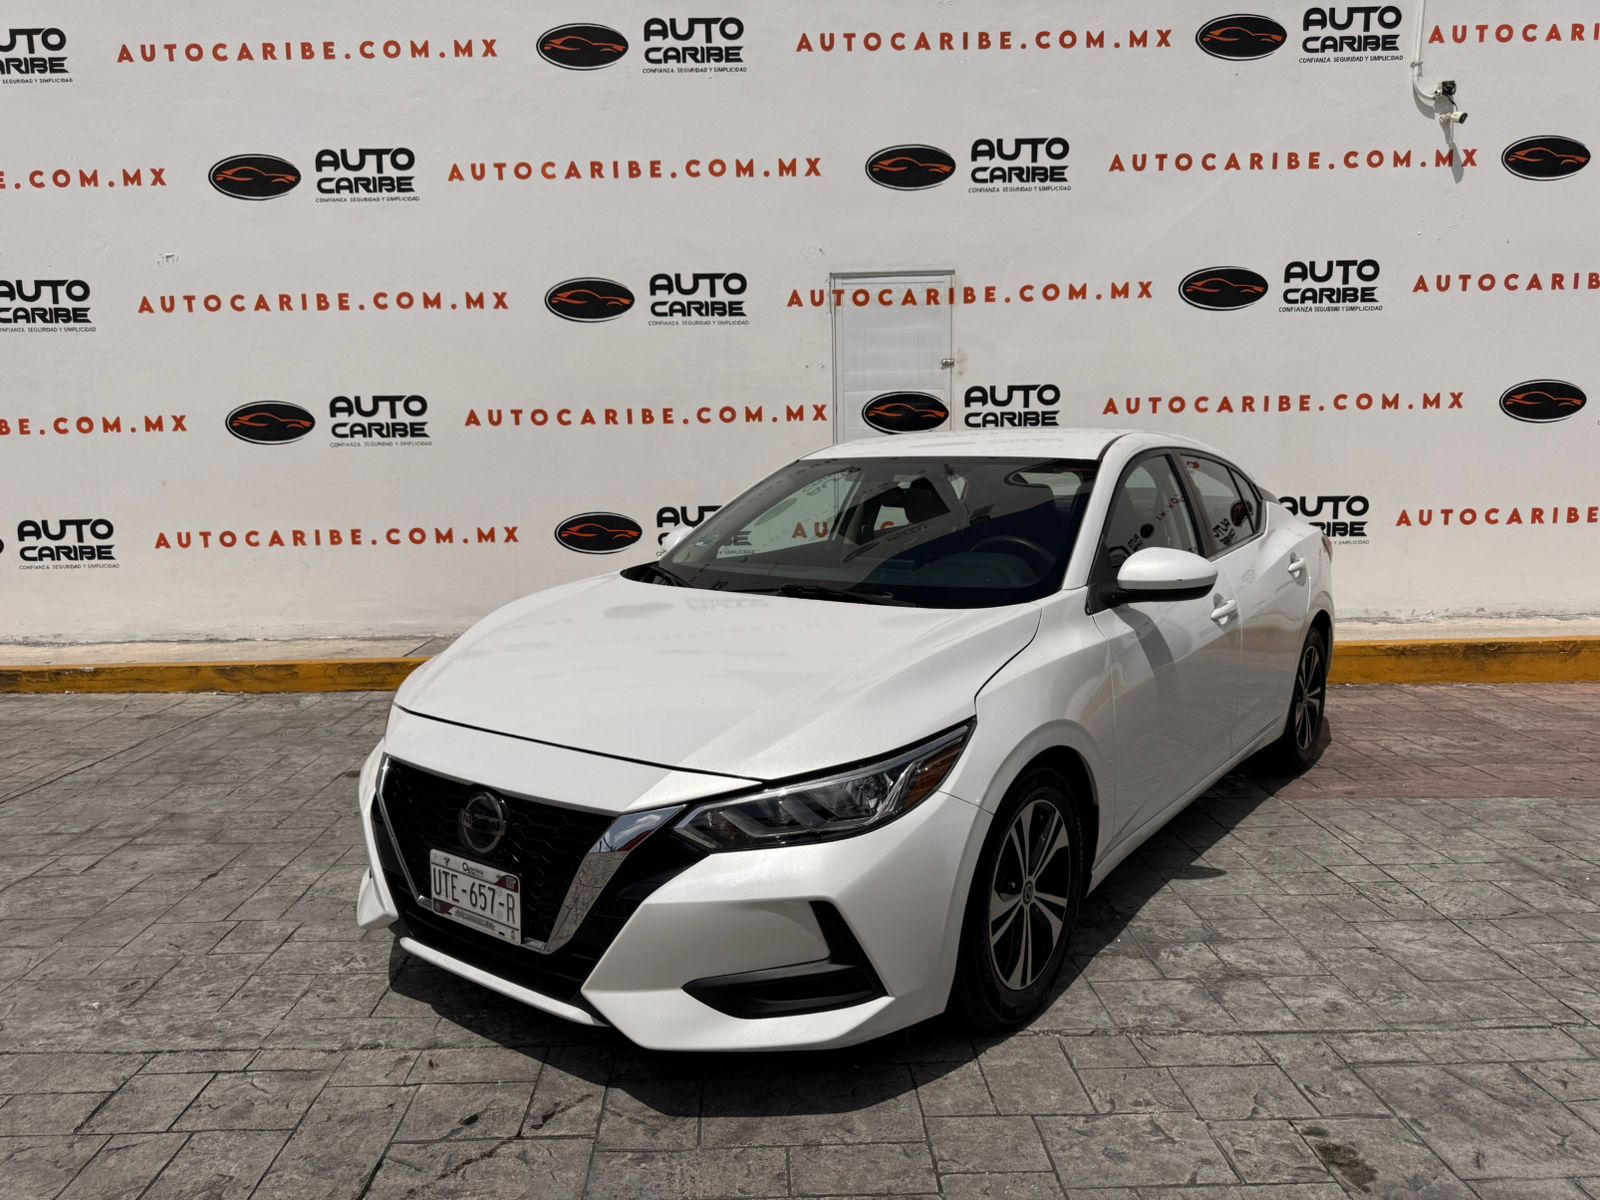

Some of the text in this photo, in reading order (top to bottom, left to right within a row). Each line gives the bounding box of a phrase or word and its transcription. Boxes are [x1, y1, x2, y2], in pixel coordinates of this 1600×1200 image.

[644, 17, 745, 43] AUTO
[1303, 5, 1402, 32] AUTO
[118, 39, 498, 63] AUTOCARIBE.COM.MX
[796, 31, 1172, 53] AUTOCARIBE.COM.MX
[1302, 35, 1401, 54] CARIBE
[644, 46, 744, 64] CARIBE
[315, 147, 415, 174] AUTO
[971, 138, 1070, 163] AUTO
[1109, 149, 1478, 173] AUTOCARIBE.COM.MX
[448, 159, 822, 183] AUTOCARIBE.COM.MX
[970, 166, 1069, 184] CARIBE
[316, 176, 416, 194] CARIBE
[1284, 259, 1381, 285] AUTO
[0, 280, 91, 305] AUTO
[650, 273, 747, 298] AUTO
[787, 282, 1153, 307] AUTOCARIBE.COM.MX
[1283, 287, 1379, 304] CARIBE
[138, 292, 510, 314] AUTOCARIBE.COM.MX
[650, 301, 747, 317] CARIBE
[0, 307, 92, 323] CARIBE
[329, 395, 428, 420] AUTO
[964, 384, 1061, 408] AUTO
[1103, 392, 1464, 415] AUTOCARIBE.COM.MX
[465, 404, 828, 427] AUTOCARIBE.COM.MX
[964, 411, 1060, 428] CARIBE
[331, 421, 430, 439] CARIBE
[656, 505, 722, 528] AU
[1278, 495, 1370, 520] AUTO
[17, 518, 114, 543] AUTO
[155, 526, 519, 549] AUTOCARIBE.COM.MX
[1308, 521, 1368, 537] RIBE
[19, 545, 116, 562] CARIBE
[432, 868, 516, 925] UTE-657-R
